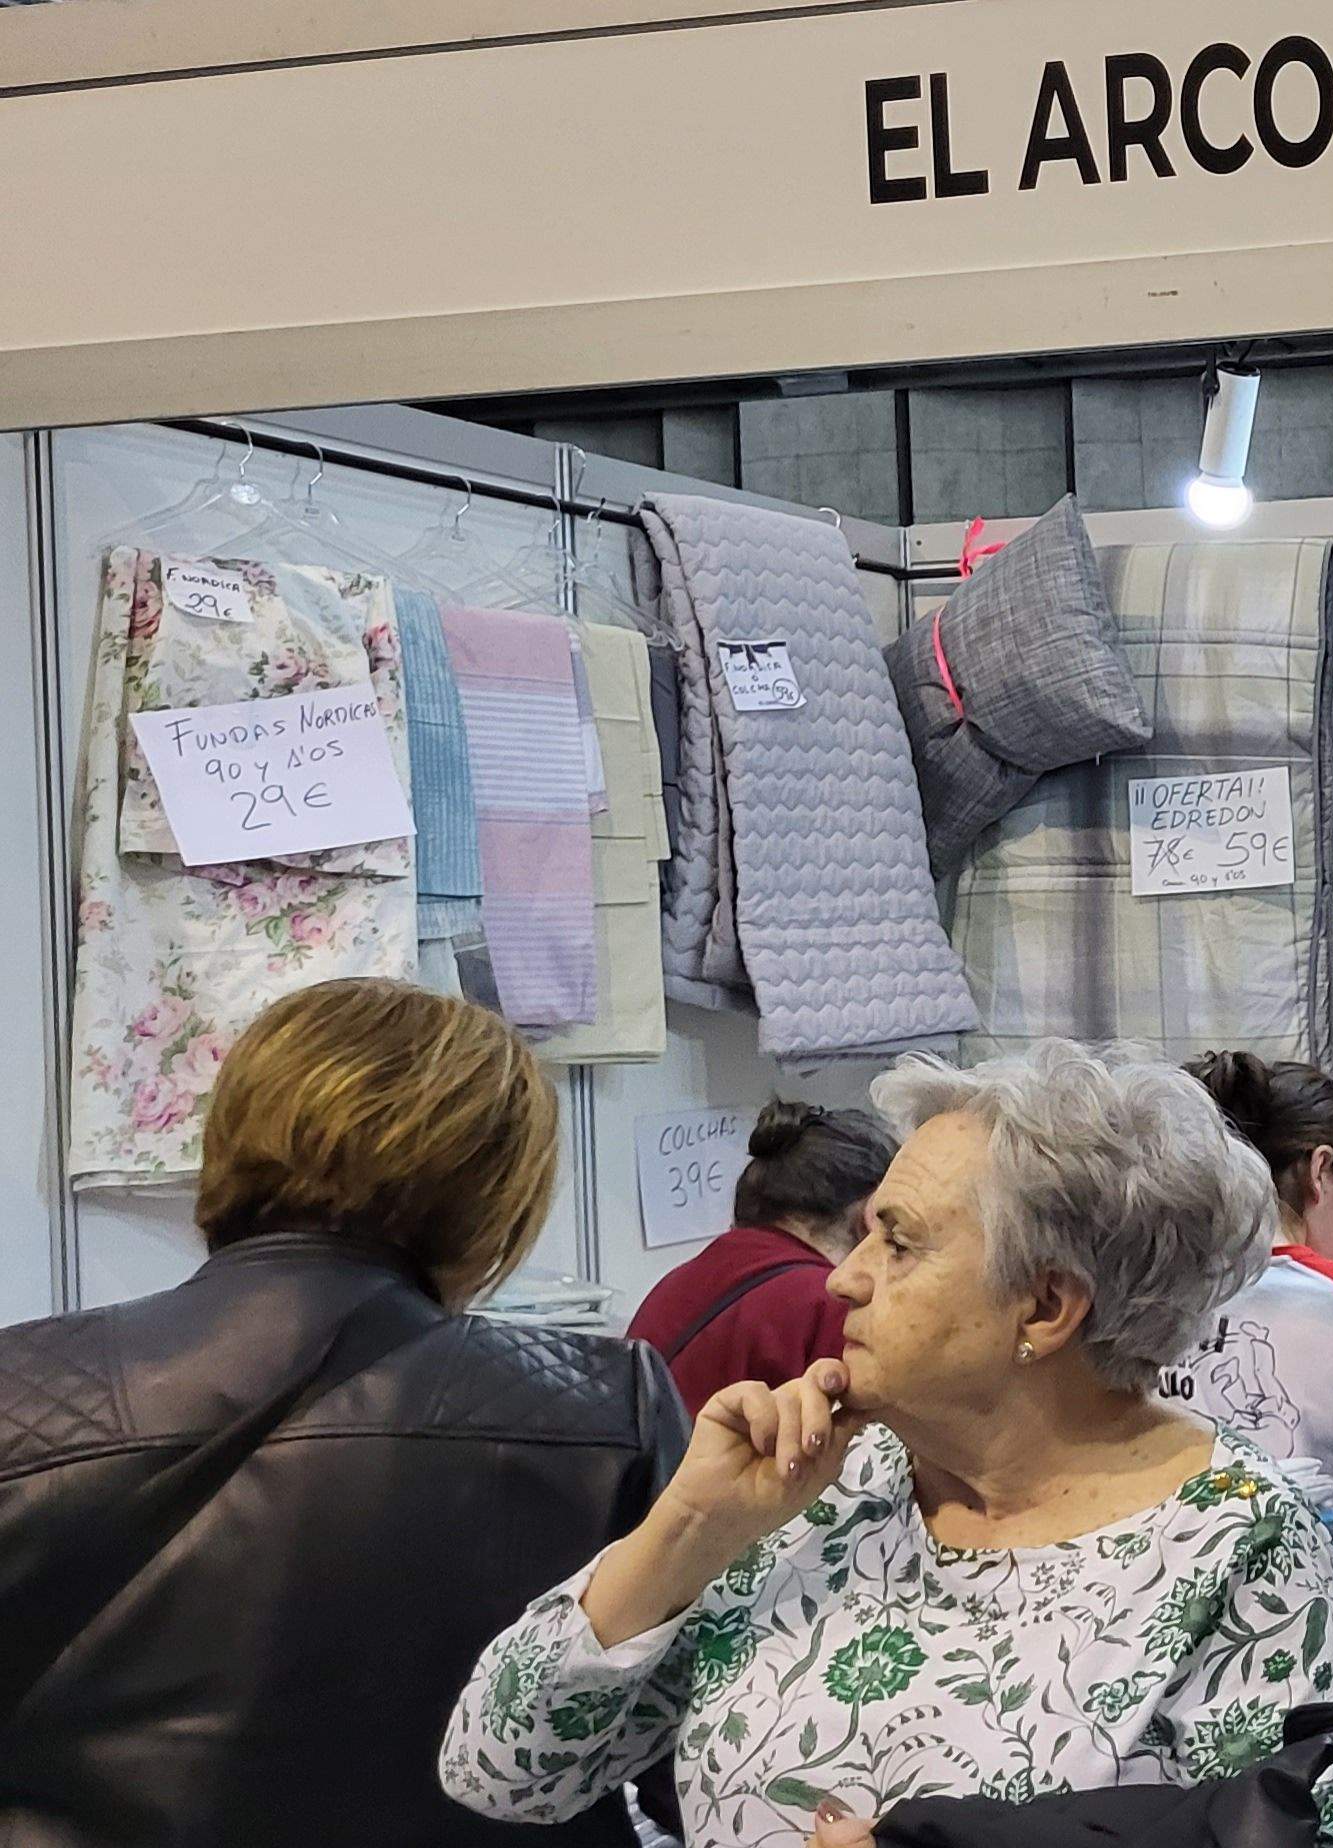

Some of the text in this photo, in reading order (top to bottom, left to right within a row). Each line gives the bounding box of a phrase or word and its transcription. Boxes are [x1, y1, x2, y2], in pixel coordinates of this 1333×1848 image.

[865, 72, 989, 204] EL
[165, 702, 378, 757] FUNDAS NORDICAS
[205, 758, 242, 783] 90
[230, 782, 333, 831] 29€
[1151, 800, 1268, 831] EDREDON
[1217, 832, 1291, 867] 59€
[659, 1116, 737, 1157] COLCHAS
[667, 1160, 724, 1208] 39€
